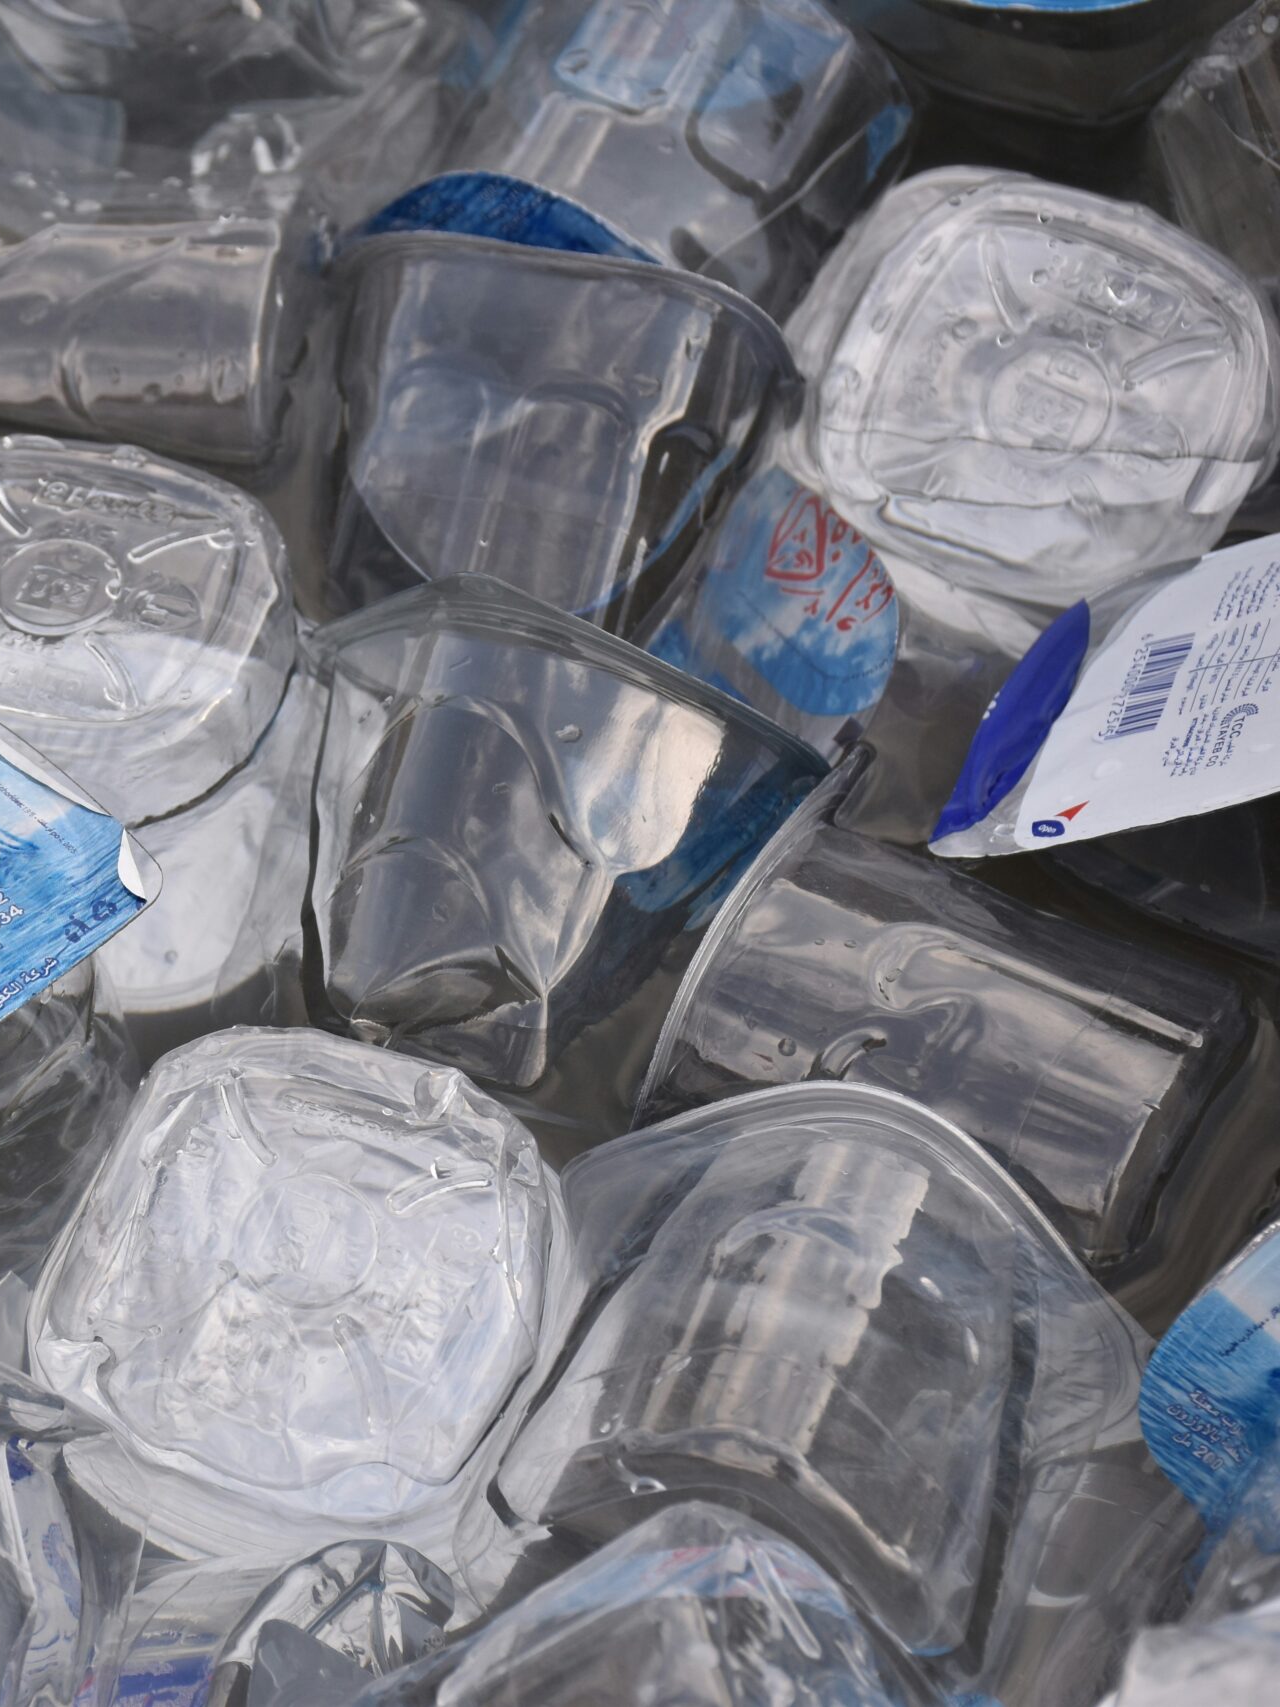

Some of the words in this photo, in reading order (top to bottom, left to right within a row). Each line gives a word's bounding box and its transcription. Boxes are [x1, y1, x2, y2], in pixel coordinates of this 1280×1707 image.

[1227, 714, 1246, 739] TCC
[19, 954, 62, 988] شركة
[1169, 1399, 1219, 1445] بالاوزون
[1174, 1429, 1192, 1447] مل
